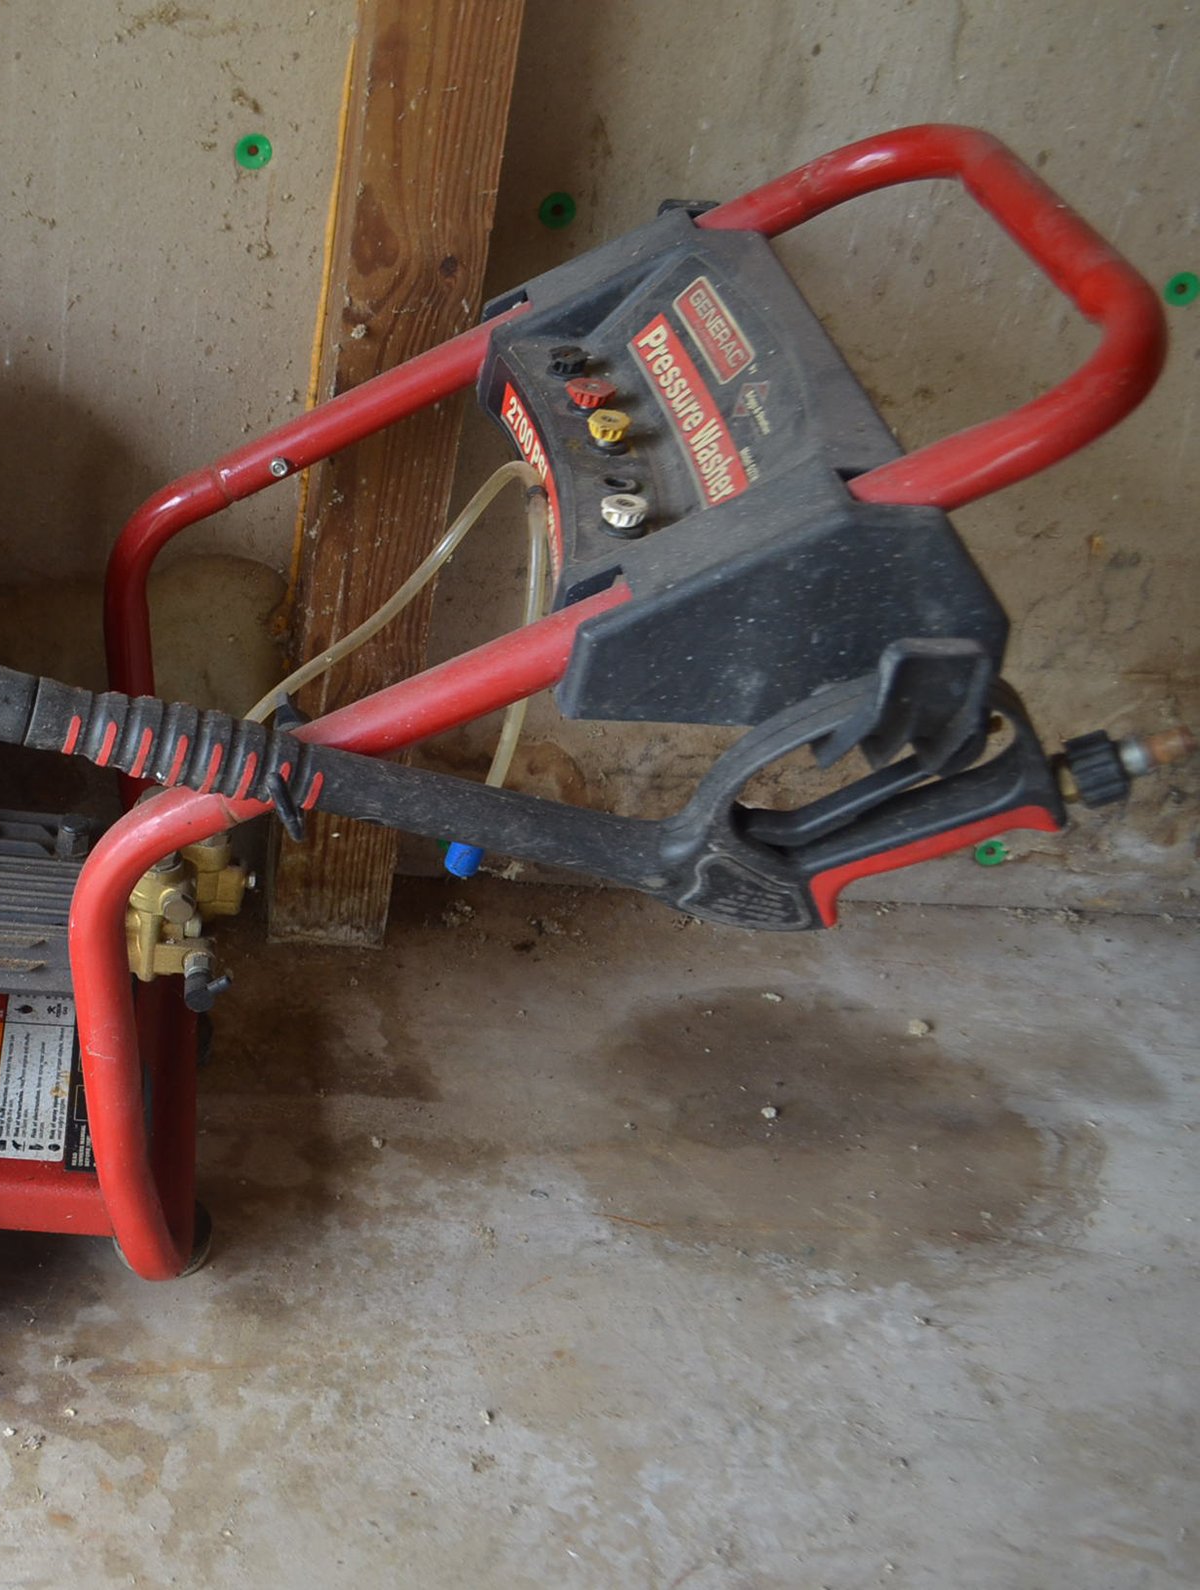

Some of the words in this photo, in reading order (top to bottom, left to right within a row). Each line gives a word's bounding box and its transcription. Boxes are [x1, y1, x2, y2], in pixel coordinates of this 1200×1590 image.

[689, 288, 747, 368] GENERAC
[506, 396, 534, 455] 2700
[637, 325, 705, 432] Pressure
[690, 418, 735, 502] Washer
